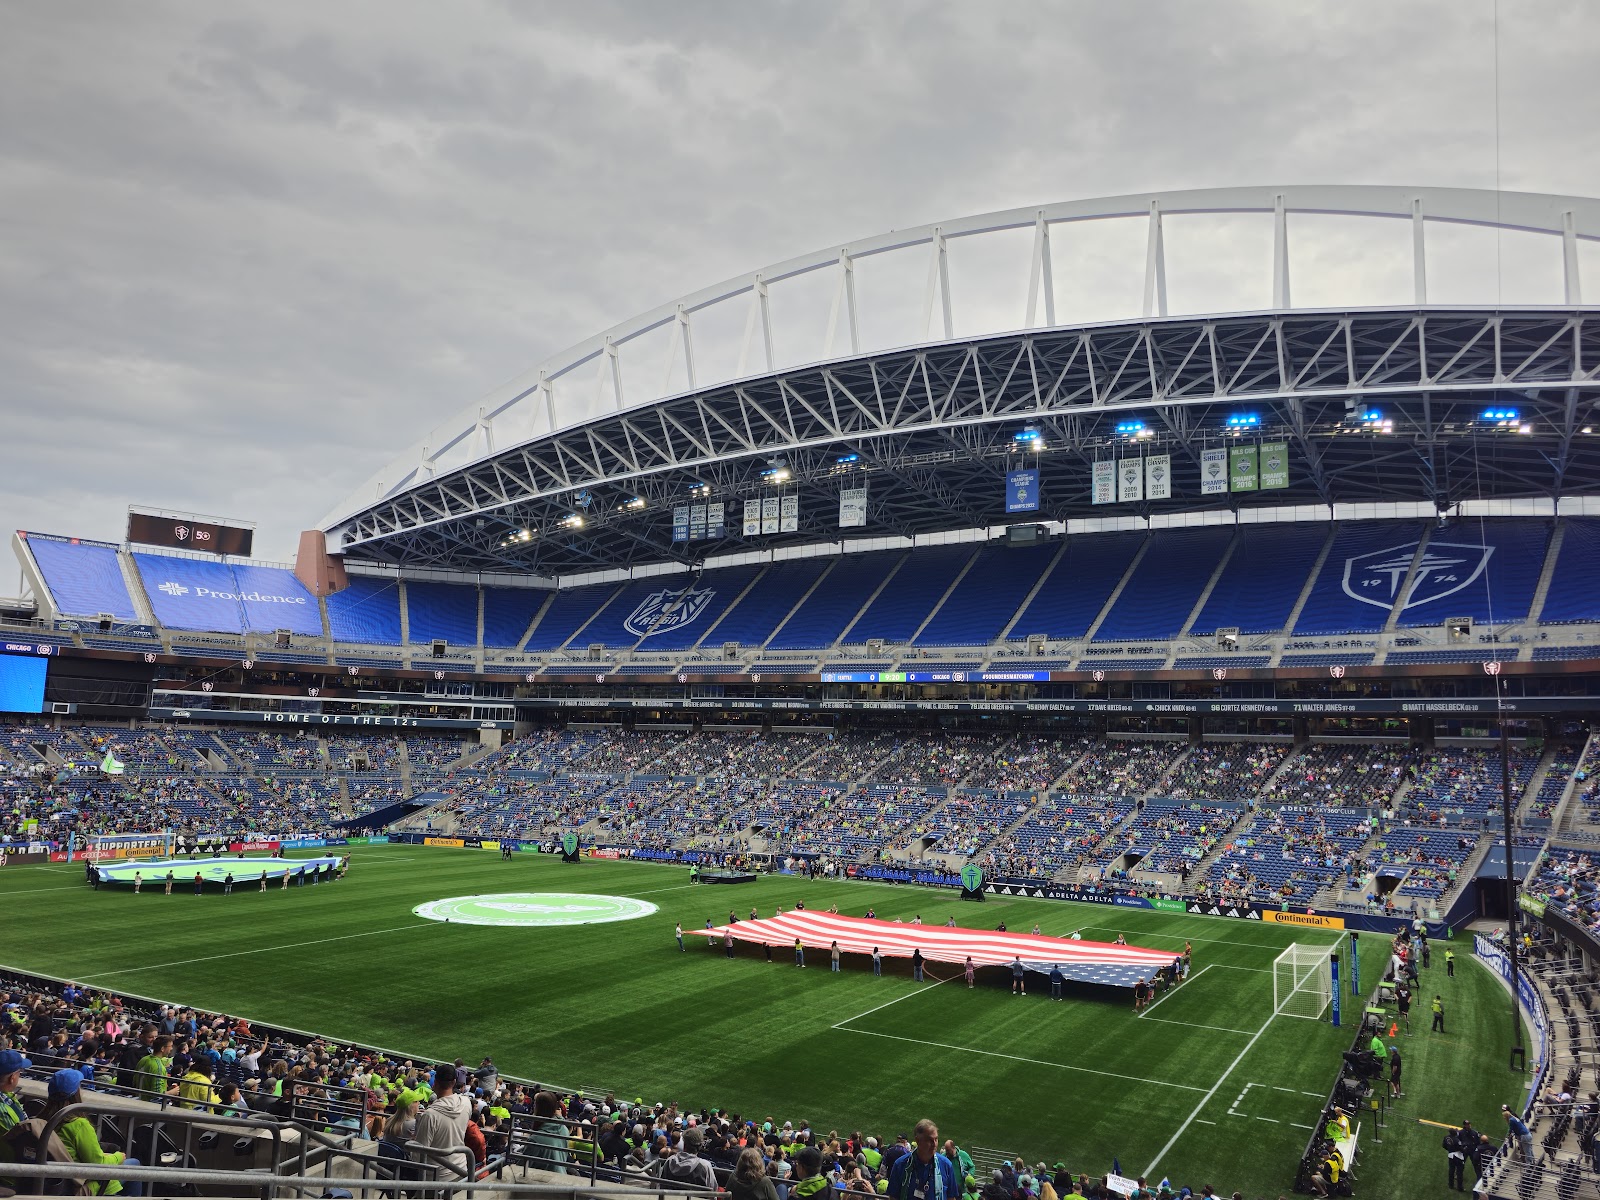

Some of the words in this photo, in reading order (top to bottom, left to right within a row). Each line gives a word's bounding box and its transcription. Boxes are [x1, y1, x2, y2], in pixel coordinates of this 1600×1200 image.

[1232, 475, 1256, 483] CHAMPS
[1262, 472, 1287, 480] CHAMPS
[1236, 481, 1253, 489] 2016
[1266, 478, 1283, 486] 2019
[1361, 579, 1382, 587] 19
[1433, 574, 1457, 584] 74
[194, 587, 306, 605] Providence
[638, 616, 680, 626] REGN
[6, 643, 32, 652] CHICAGO
[264, 713, 310, 722] HOME
[322, 715, 340, 724] OF
[353, 716, 380, 725] THE
[393, 718, 417, 726] 12s
[125, 848, 161, 857] Continental
[1055, 892, 1079, 900] DELTA
[1089, 895, 1113, 903] DELTA
[1275, 912, 1323, 925] Continental
